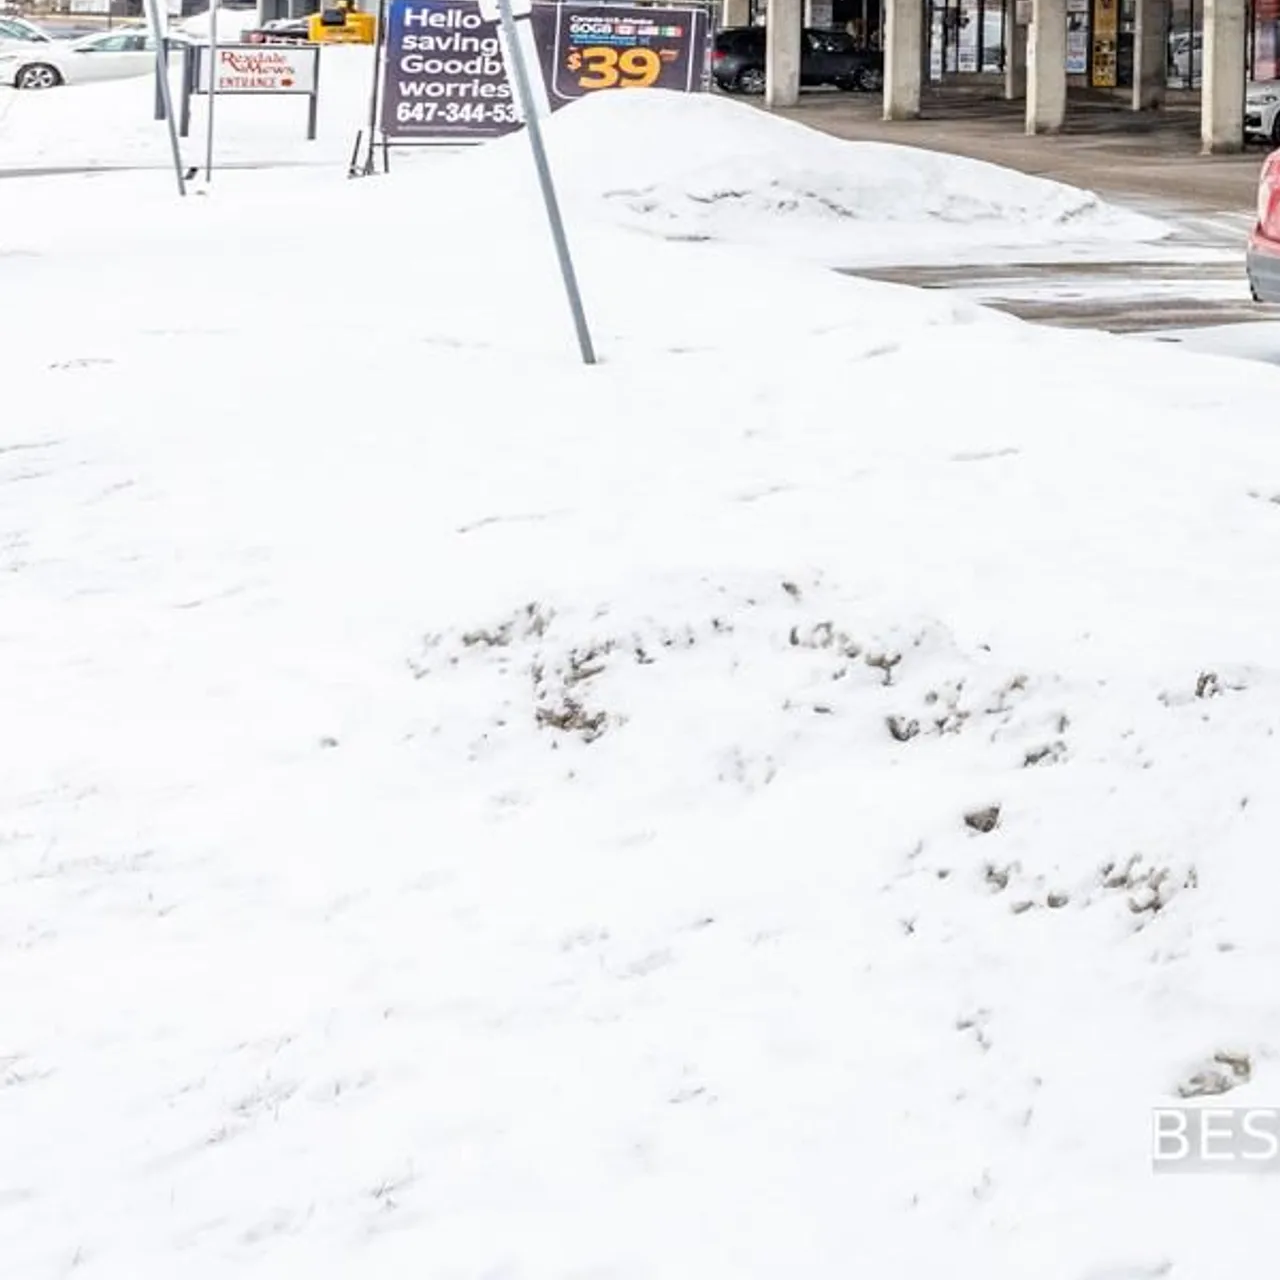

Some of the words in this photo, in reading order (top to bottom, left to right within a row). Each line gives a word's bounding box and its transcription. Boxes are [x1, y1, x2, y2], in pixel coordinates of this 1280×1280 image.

[404, 7, 481, 29] Hello
[401, 32, 499, 57] saving
[400, 54, 504, 76] Goodb
[399, 79, 512, 98] worries
[396, 102, 520, 122] 647-344-53
